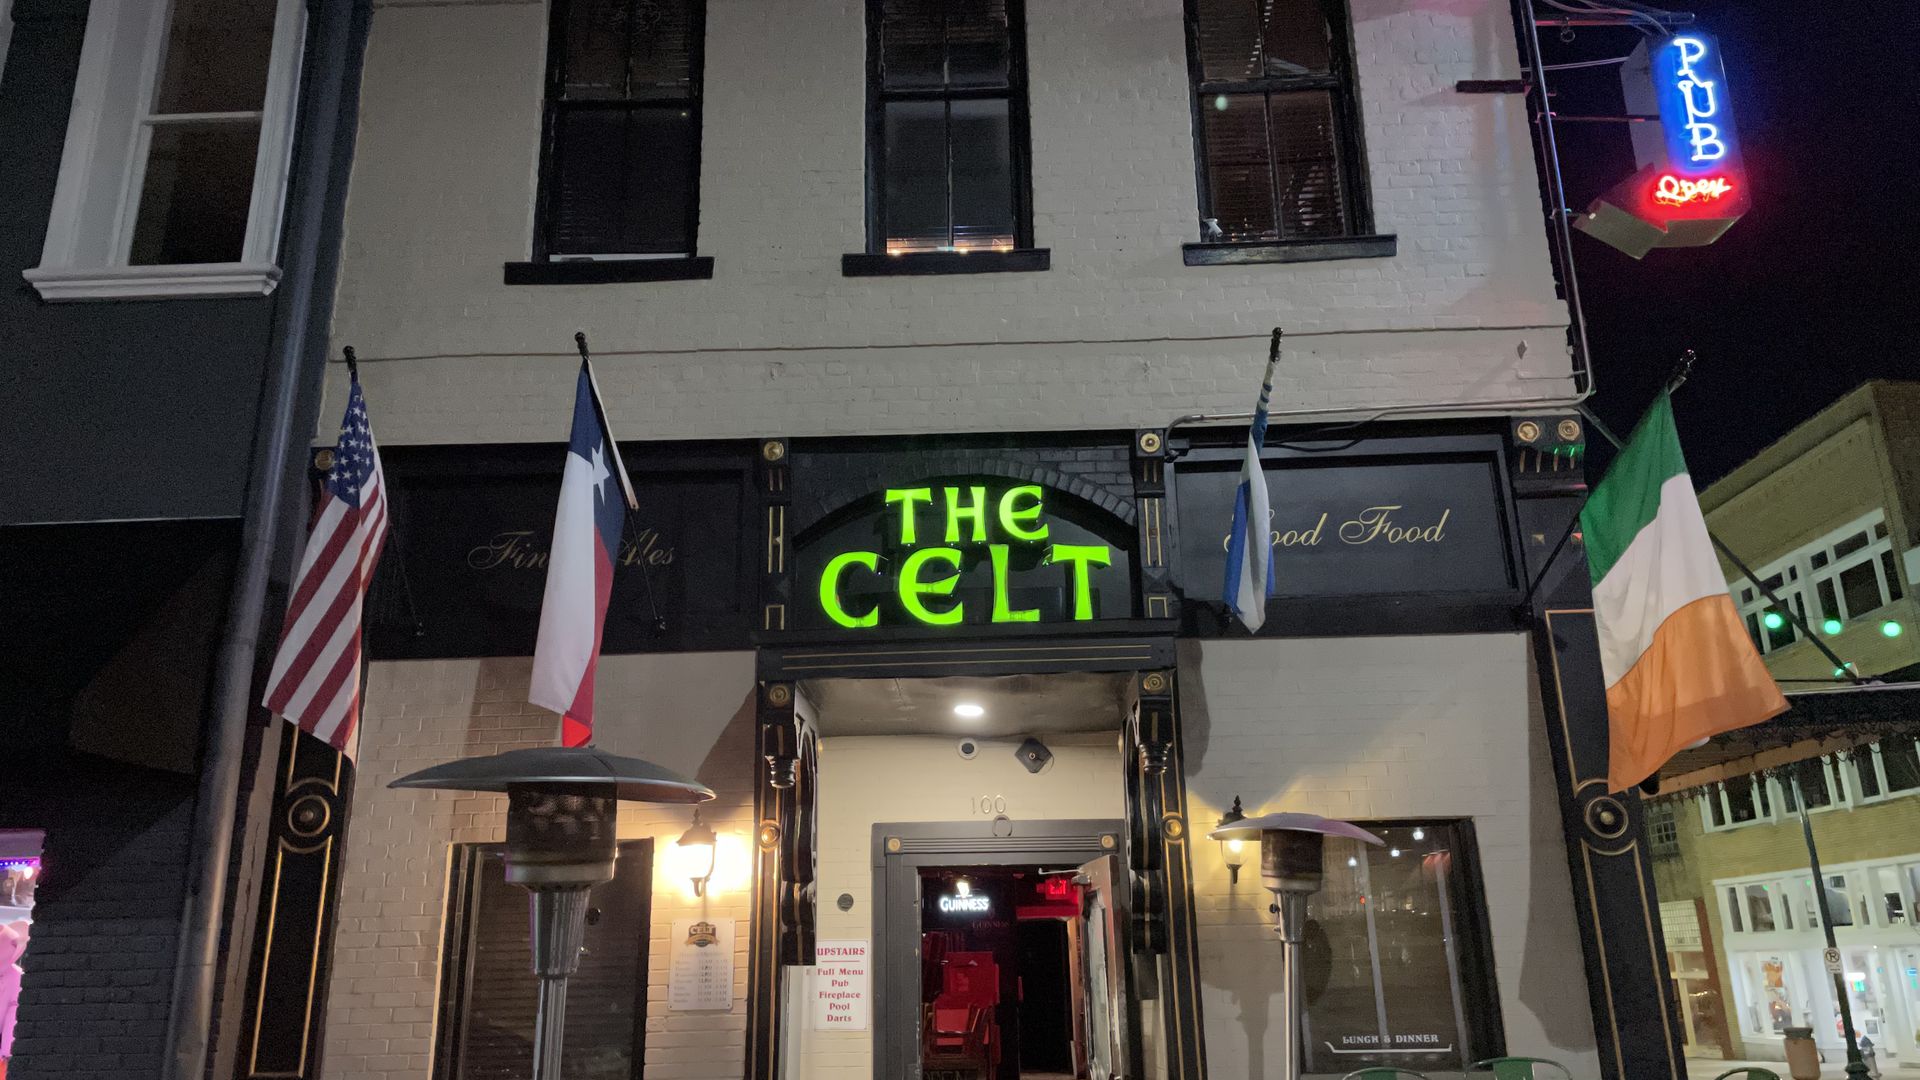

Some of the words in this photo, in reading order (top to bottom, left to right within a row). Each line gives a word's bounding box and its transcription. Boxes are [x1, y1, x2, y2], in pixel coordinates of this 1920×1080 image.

[1673, 37, 1725, 161] PUB
[885, 485, 1049, 545] THE
[1223, 508, 1328, 552] ood
[1339, 505, 1450, 545] Food
[819, 543, 1112, 628] CELT
[971, 794, 1006, 815] 100
[939, 896, 990, 912] GUINNESS
[817, 947, 865, 956] UPSTAIRS
[817, 968, 835, 976] Full
[838, 968, 864, 976] Menu
[831, 979, 849, 987] Pub
[819, 991, 861, 1000] Fireplace
[829, 1002, 850, 1011] Pool
[827, 1014, 852, 1022] Darts
[1395, 1034, 1439, 1043] DINNER
